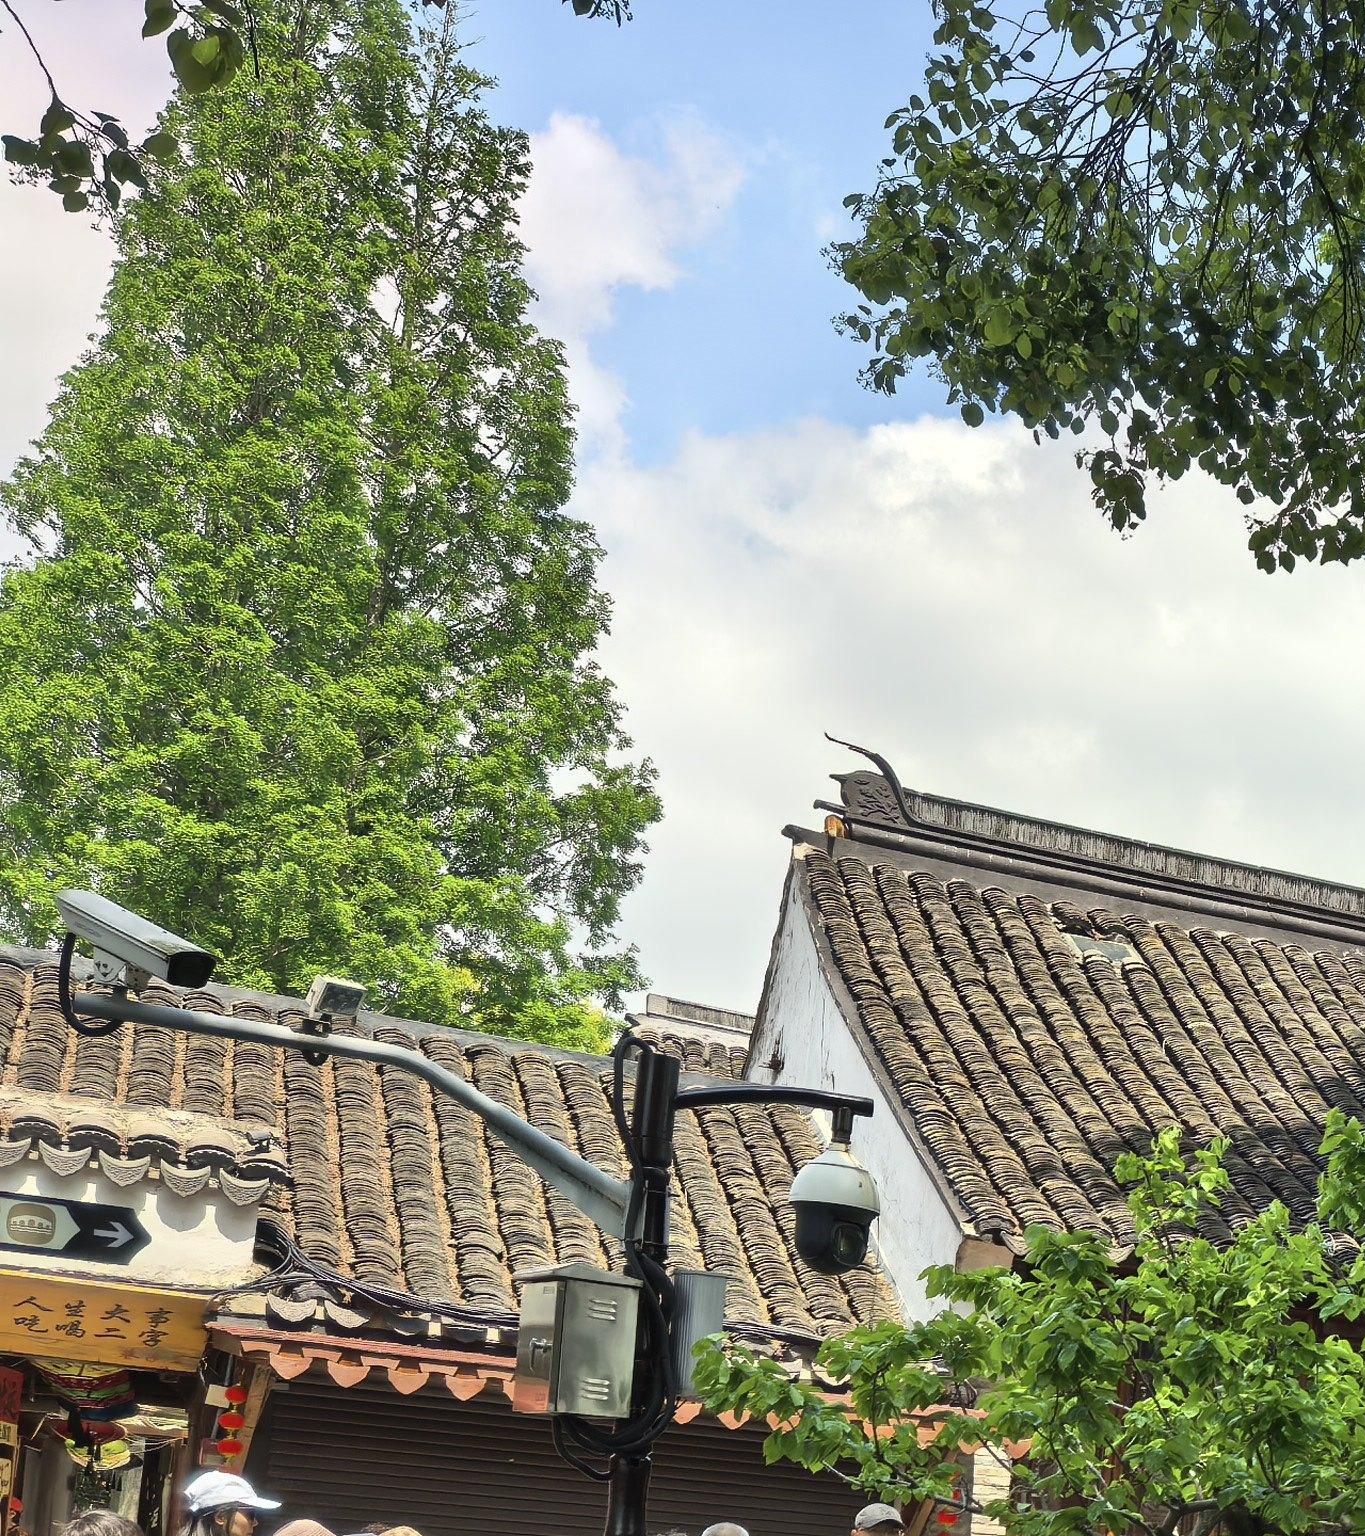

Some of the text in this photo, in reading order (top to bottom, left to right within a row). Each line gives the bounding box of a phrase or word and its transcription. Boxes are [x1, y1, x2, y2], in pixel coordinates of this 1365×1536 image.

[13, 1295, 174, 1327] 人生大事
[13, 1314, 169, 1346] 吃喝二字
